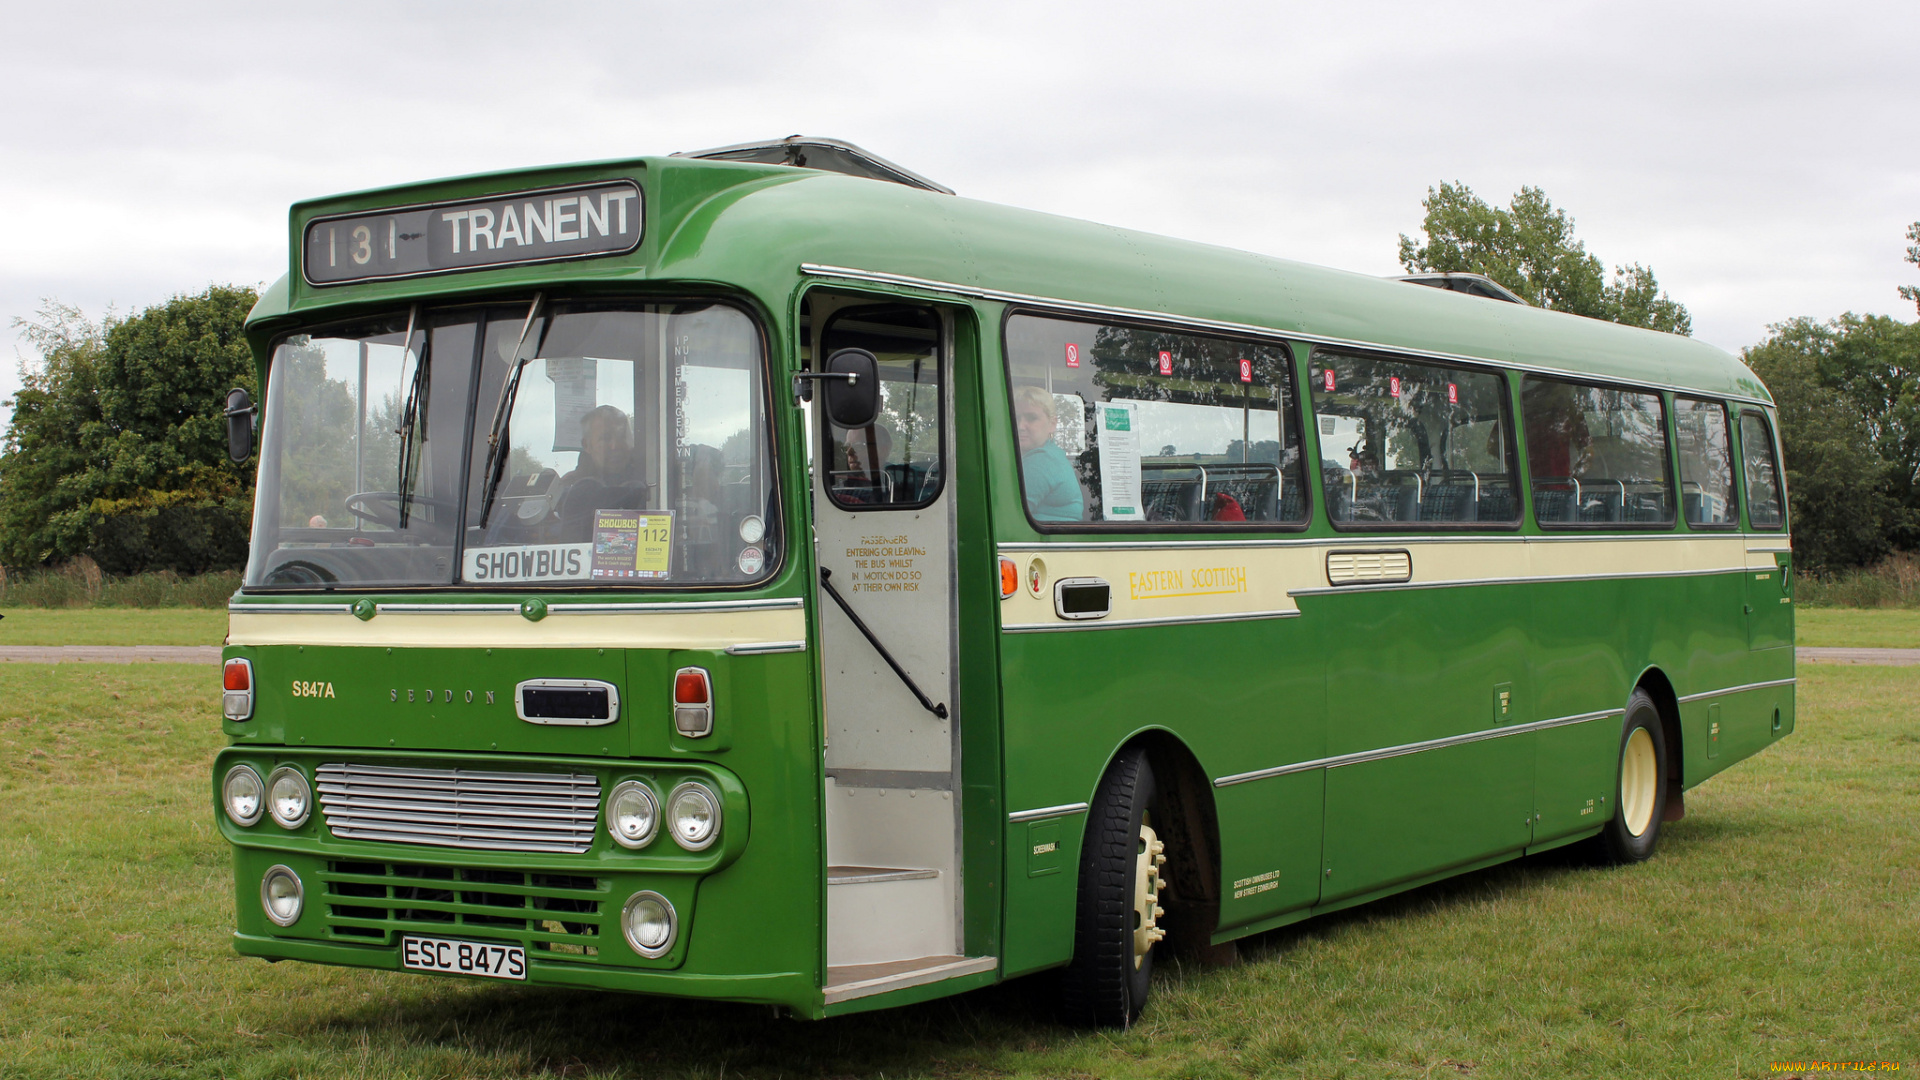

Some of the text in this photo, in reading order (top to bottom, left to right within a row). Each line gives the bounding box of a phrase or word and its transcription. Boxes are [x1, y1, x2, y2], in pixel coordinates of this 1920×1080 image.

[442, 190, 637, 254] TRANENT
[598, 518, 638, 529] SHOWBUS
[643, 528, 668, 542] 112
[846, 547, 926, 557] ENTERING OR LEAVING
[475, 549, 582, 579] SHOWBUS
[855, 559, 914, 569] THE BUS WHILST
[852, 571, 922, 581] IN MOTION DO SO
[1129, 567, 1247, 600] EASTERN SCOTTISH
[853, 582, 919, 592] AT THEIR OWN RISK
[292, 680, 336, 699] S847A
[391, 688, 495, 704] SEDDON
[404, 939, 524, 976] ESC 847S
